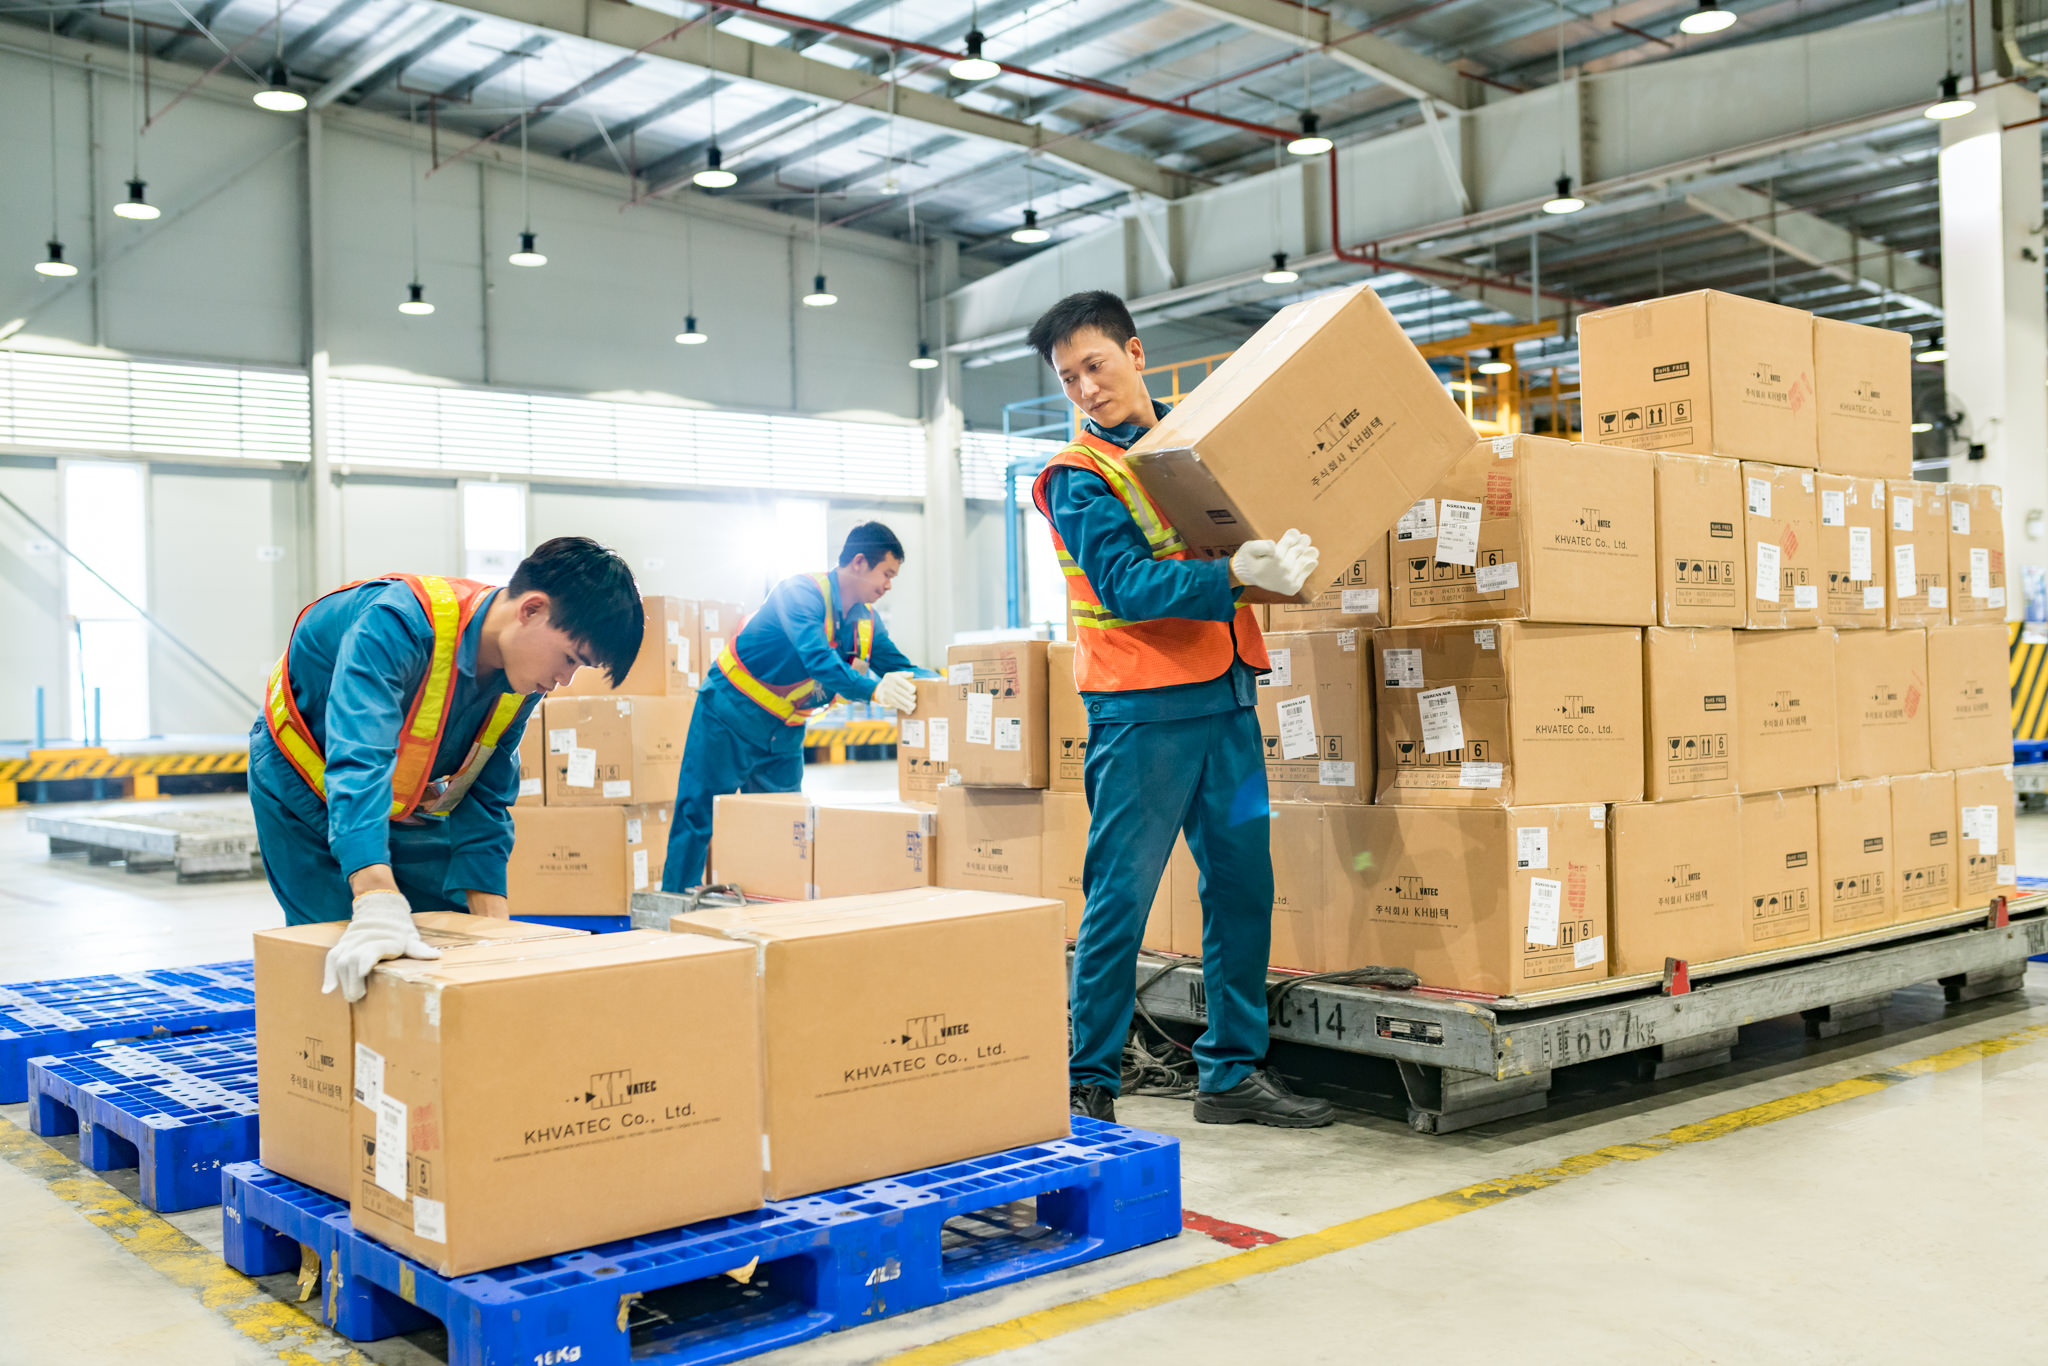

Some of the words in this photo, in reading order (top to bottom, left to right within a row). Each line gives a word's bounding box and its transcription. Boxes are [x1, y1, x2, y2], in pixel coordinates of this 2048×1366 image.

[1676, 403, 1684, 416] 6
[1311, 452, 1347, 486] 주식회사
[1347, 416, 1384, 453] KH바텍
[1555, 534, 1592, 547] KHVATEC
[1595, 538, 1611, 549] Co.,
[1614, 540, 1628, 550] Ltd.
[1489, 553, 1497, 566] 6
[1353, 563, 1360, 576] 6
[1725, 564, 1730, 577] 6
[1535, 724, 1574, 734] KHVATEC
[1577, 724, 1594, 735] Co.,
[1598, 724, 1613, 734] Ltd.
[1329, 738, 1336, 752] 6
[1719, 736, 1724, 749] 6
[1474, 743, 1482, 757] 6
[1376, 905, 1409, 917] 주식회사
[1414, 907, 1449, 920] KH바텍
[1582, 923, 1589, 937] 6
[940, 1023, 970, 1038] VATEC
[843, 1057, 927, 1083] KHVATEC
[935, 1052, 968, 1066] Co.,
[977, 1043, 1007, 1059] Ltd.
[626, 1080, 657, 1096] VATEC
[524, 1117, 611, 1146] KHVATEC
[620, 1113, 655, 1128] Co.,
[665, 1102, 696, 1120] Ltd.
